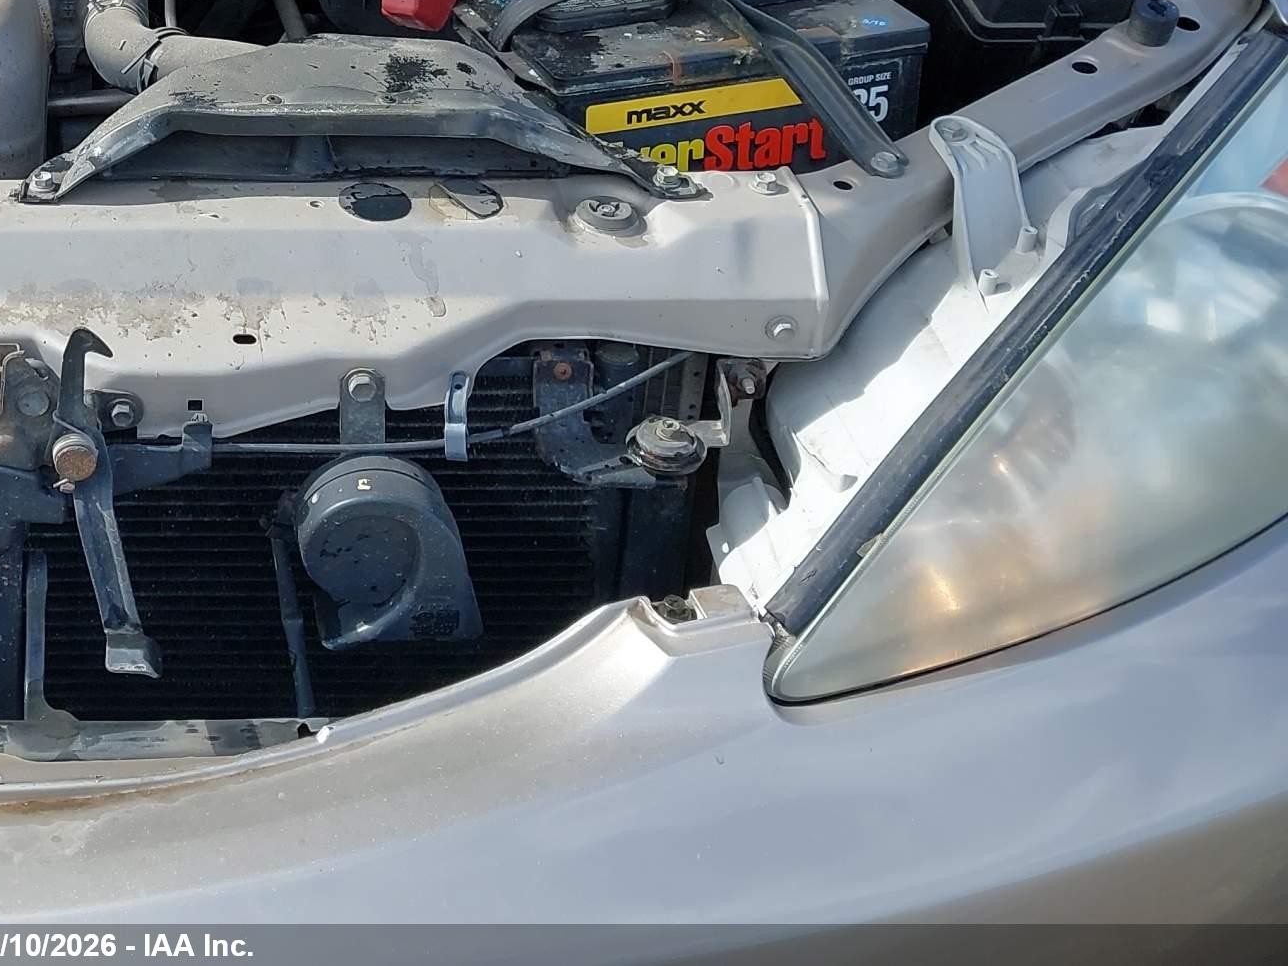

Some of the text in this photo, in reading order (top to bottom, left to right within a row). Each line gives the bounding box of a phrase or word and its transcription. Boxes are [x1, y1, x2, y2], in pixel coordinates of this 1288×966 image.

[848, 71, 892, 86] GROUP SIZE
[627, 100, 707, 125] maxx
[638, 117, 827, 172] erStart
